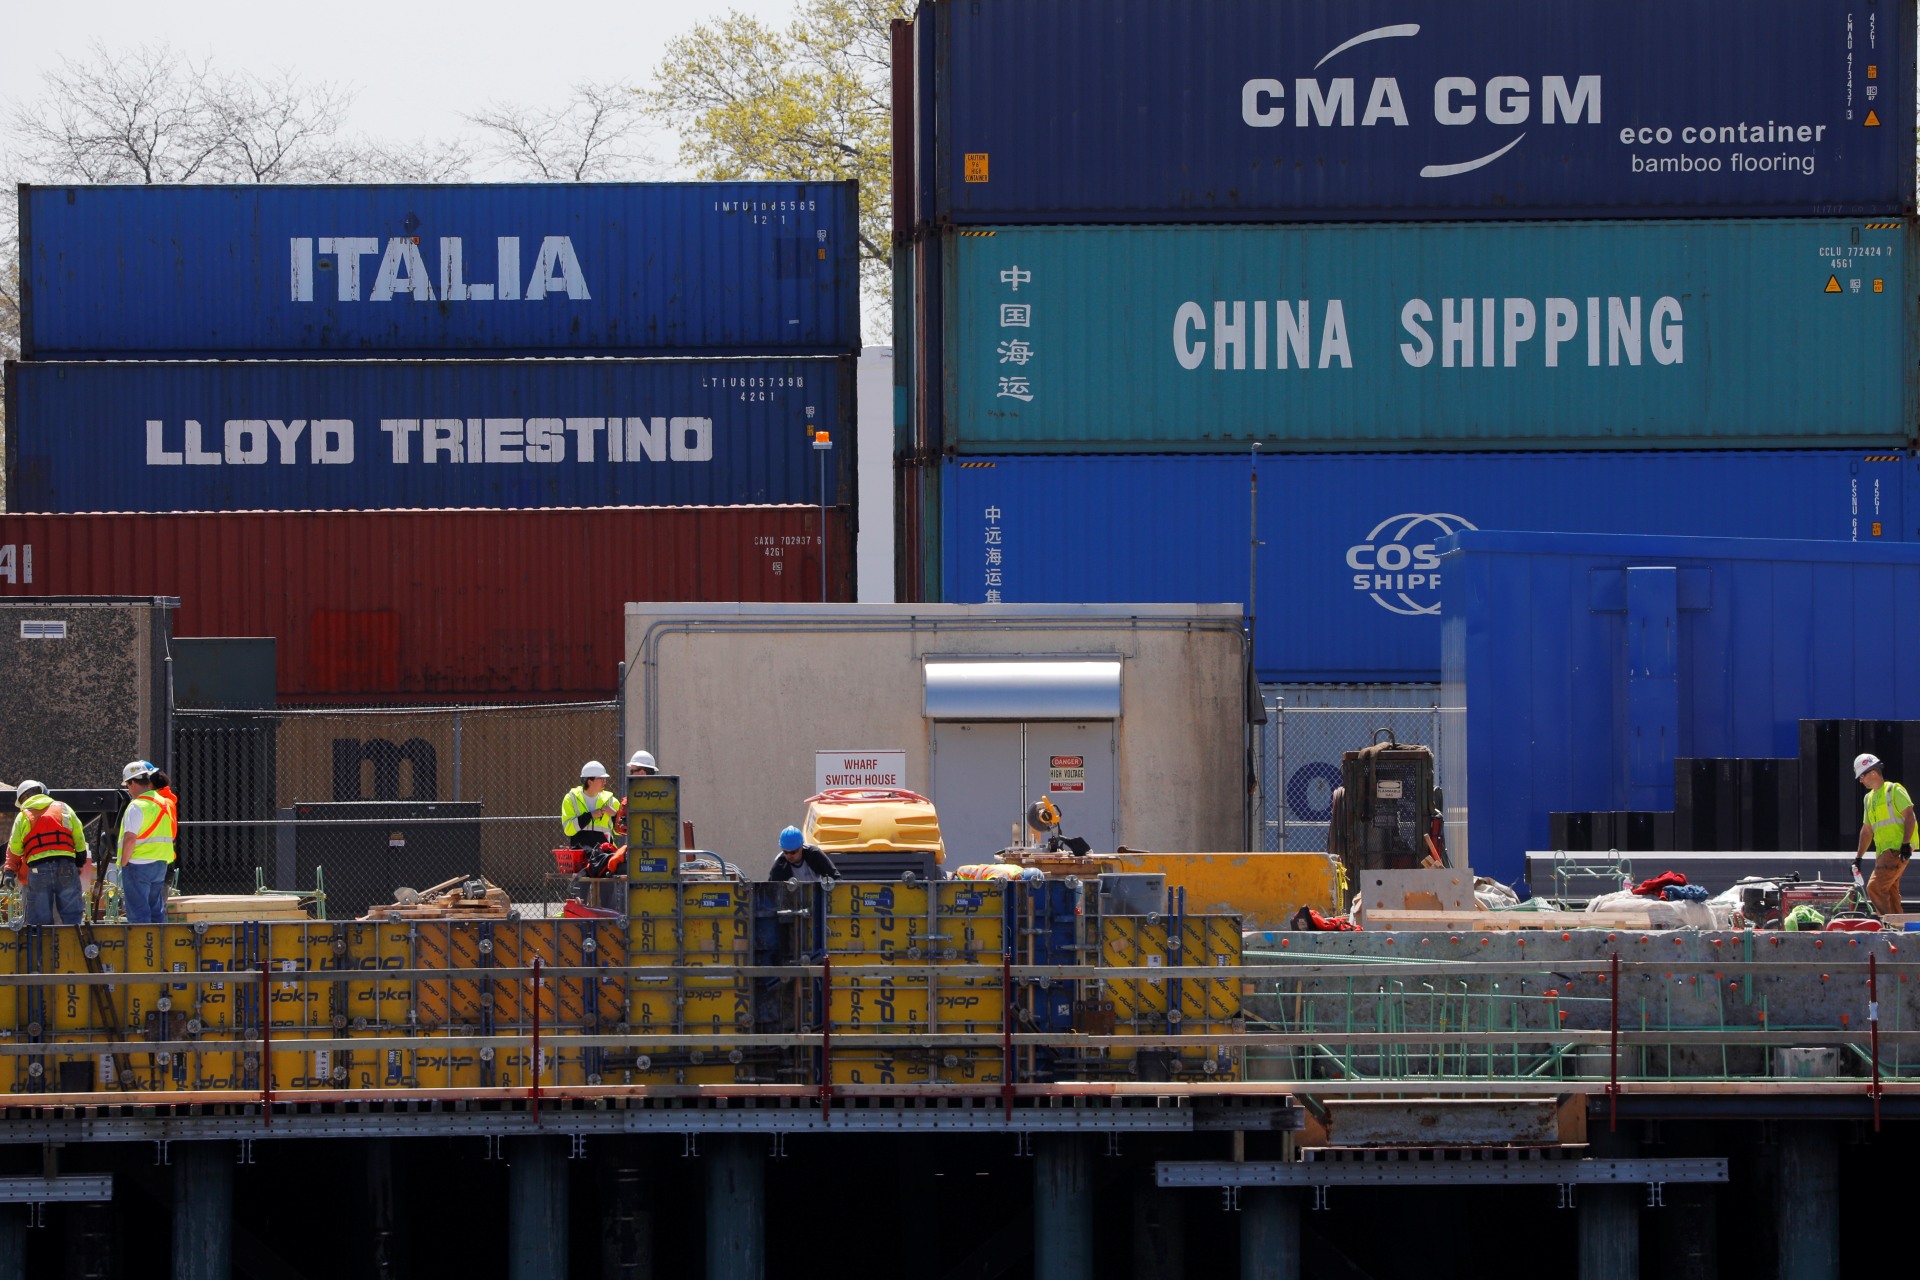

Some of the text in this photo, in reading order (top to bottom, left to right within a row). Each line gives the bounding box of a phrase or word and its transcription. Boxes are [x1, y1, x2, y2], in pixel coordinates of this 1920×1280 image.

[1242, 75, 1602, 128] CMA CGM
[1619, 120, 1827, 145] eco container
[1632, 152, 1816, 175] bamboo flooring
[1819, 246, 1841, 256] CCLU
[1848, 246, 1881, 256] 772424
[290, 235, 591, 303] ITALIA
[1831, 258, 1852, 268] 45G1
[997, 265, 1034, 402] 中国海运
[1173, 295, 1685, 370] CHINA SHIPPING
[740, 392, 774, 401] 42G1
[146, 416, 713, 465] LLOYD TRIESTINO
[332, 737, 437, 801] m
[844, 759, 878, 770] WHARF
[1051, 769, 1084, 778] HIGH VOLTAGE
[825, 773, 896, 786] SWITCH HOUSE
[358, 987, 411, 1002] doka
